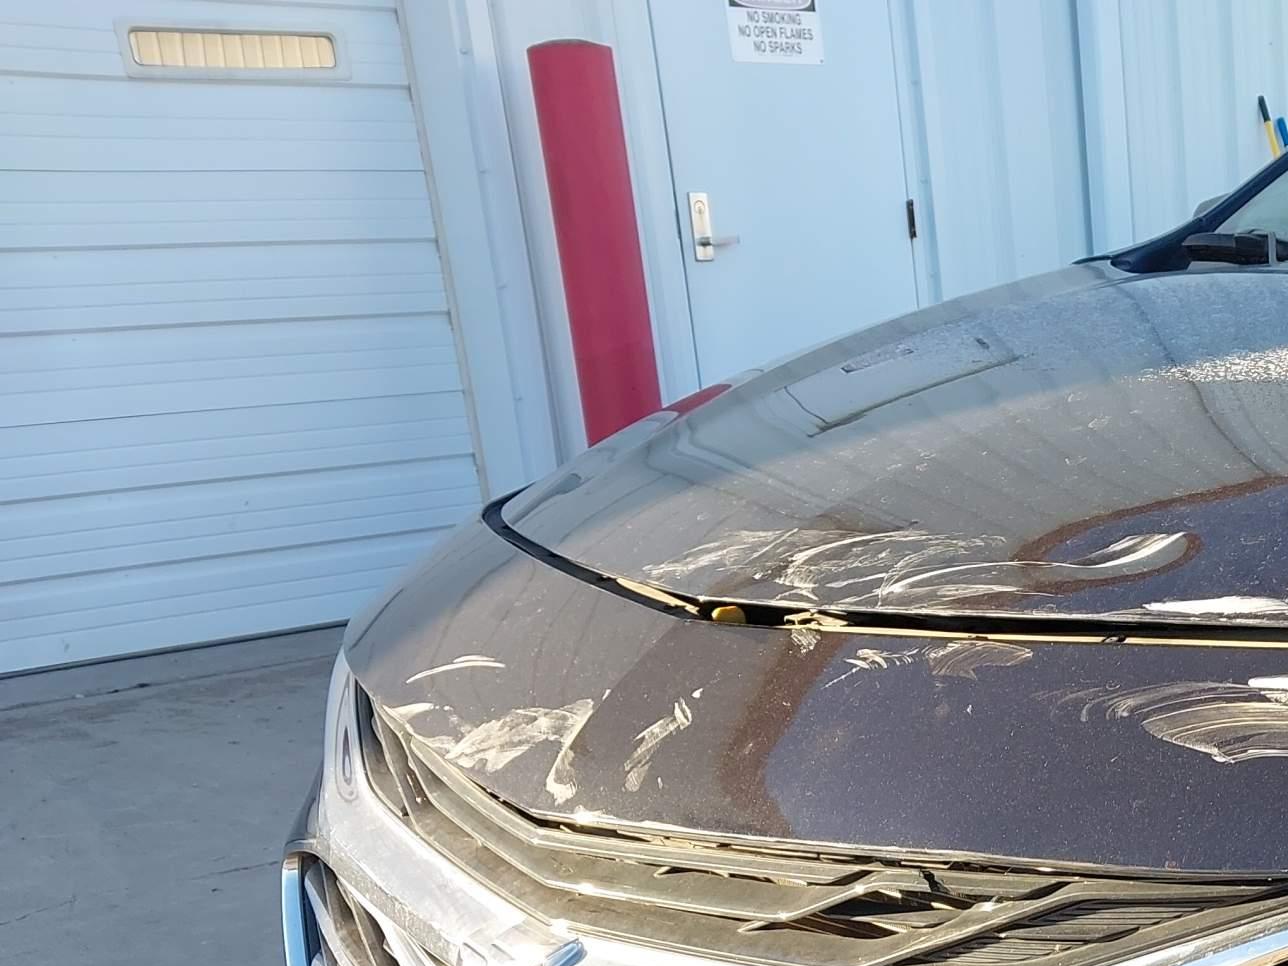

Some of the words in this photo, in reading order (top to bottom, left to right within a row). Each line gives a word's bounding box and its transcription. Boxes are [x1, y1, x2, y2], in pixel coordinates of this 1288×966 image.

[747, 10, 760, 23] NO
[762, 11, 801, 26] SMOKING
[738, 24, 751, 38] NO
[753, 25, 777, 39] OPEN
[779, 27, 814, 40] FLAMES
[753, 40, 766, 53] NO
[768, 41, 802, 54] SPARKS
